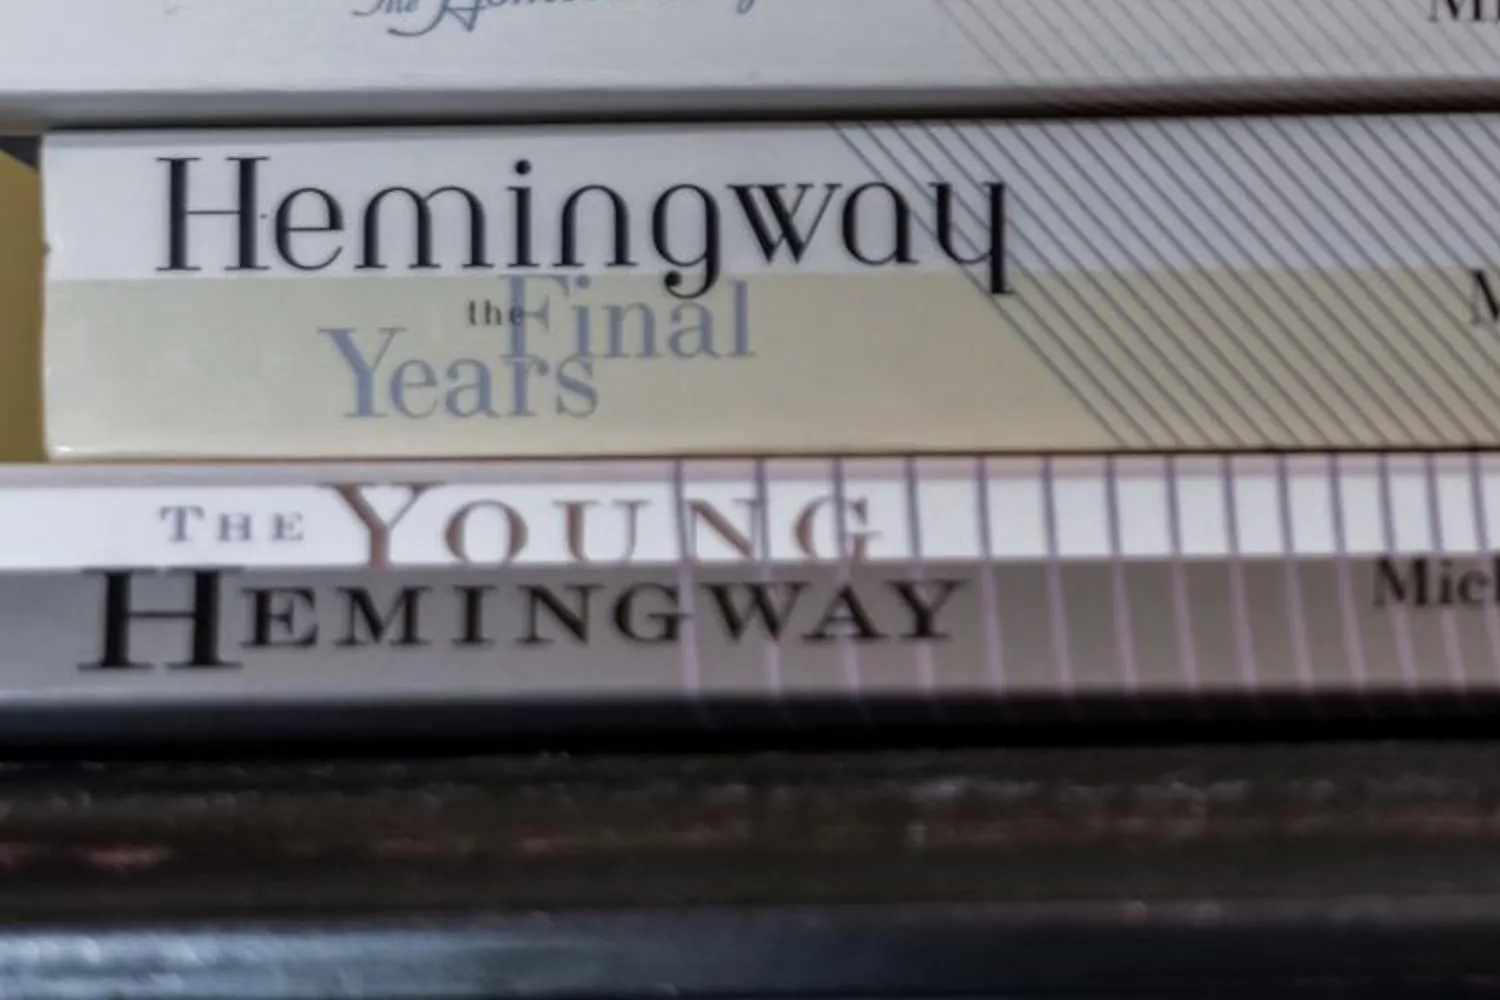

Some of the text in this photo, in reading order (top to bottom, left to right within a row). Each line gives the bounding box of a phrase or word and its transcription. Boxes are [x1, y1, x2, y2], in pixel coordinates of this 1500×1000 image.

[155, 157, 1012, 298] Hemingway
[468, 273, 757, 360] the Final
[317, 327, 599, 419] Years
[161, 482, 882, 568] THE YOUNG
[77, 566, 971, 673] HEMINGWAY
